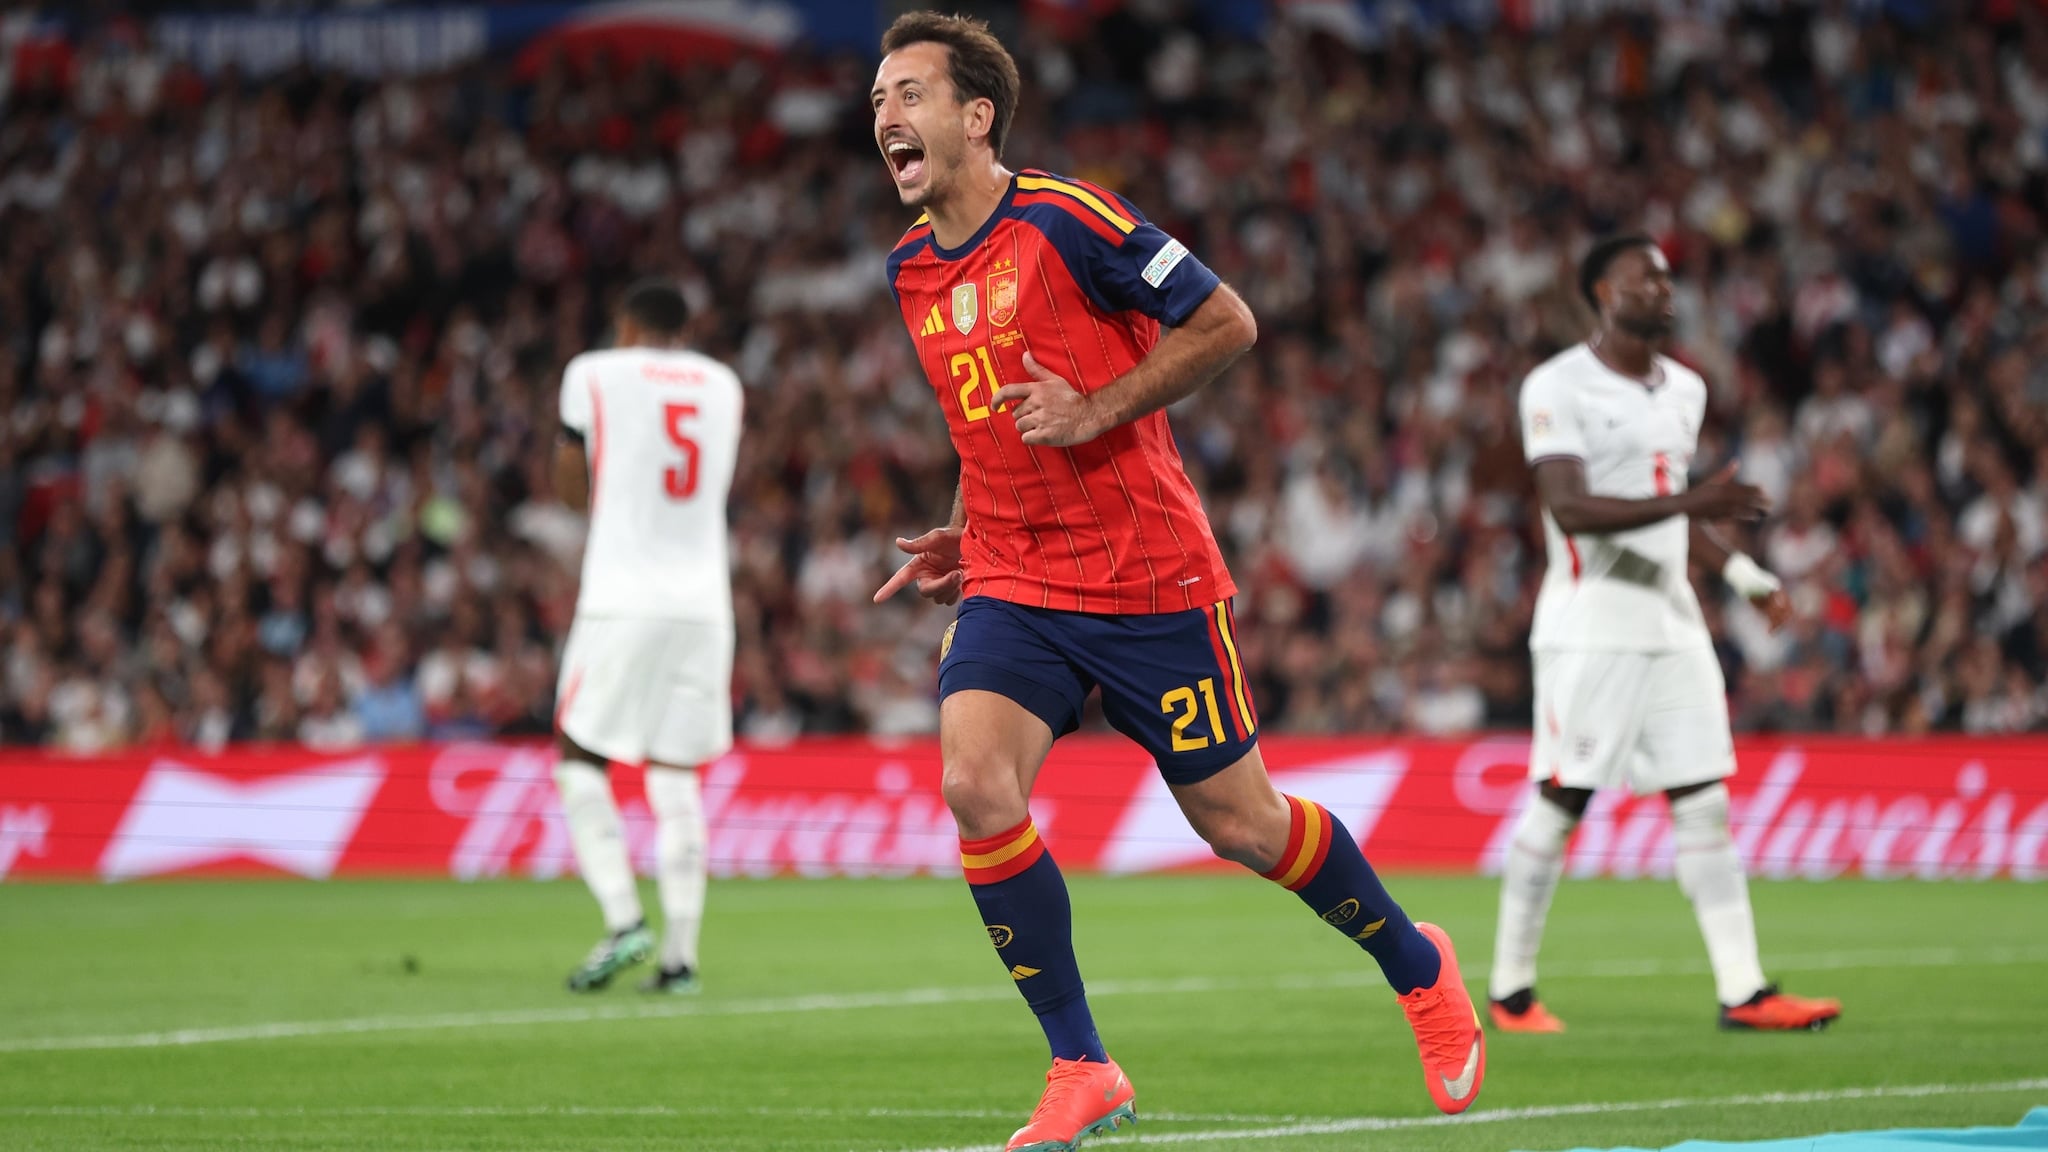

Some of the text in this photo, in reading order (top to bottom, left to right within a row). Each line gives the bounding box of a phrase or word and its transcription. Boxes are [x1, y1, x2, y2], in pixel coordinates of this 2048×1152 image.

[1146, 244, 1183, 283] FOUNDAT
[951, 346, 1006, 422] 21
[664, 403, 700, 500] 5
[1161, 678, 1226, 752] 21
